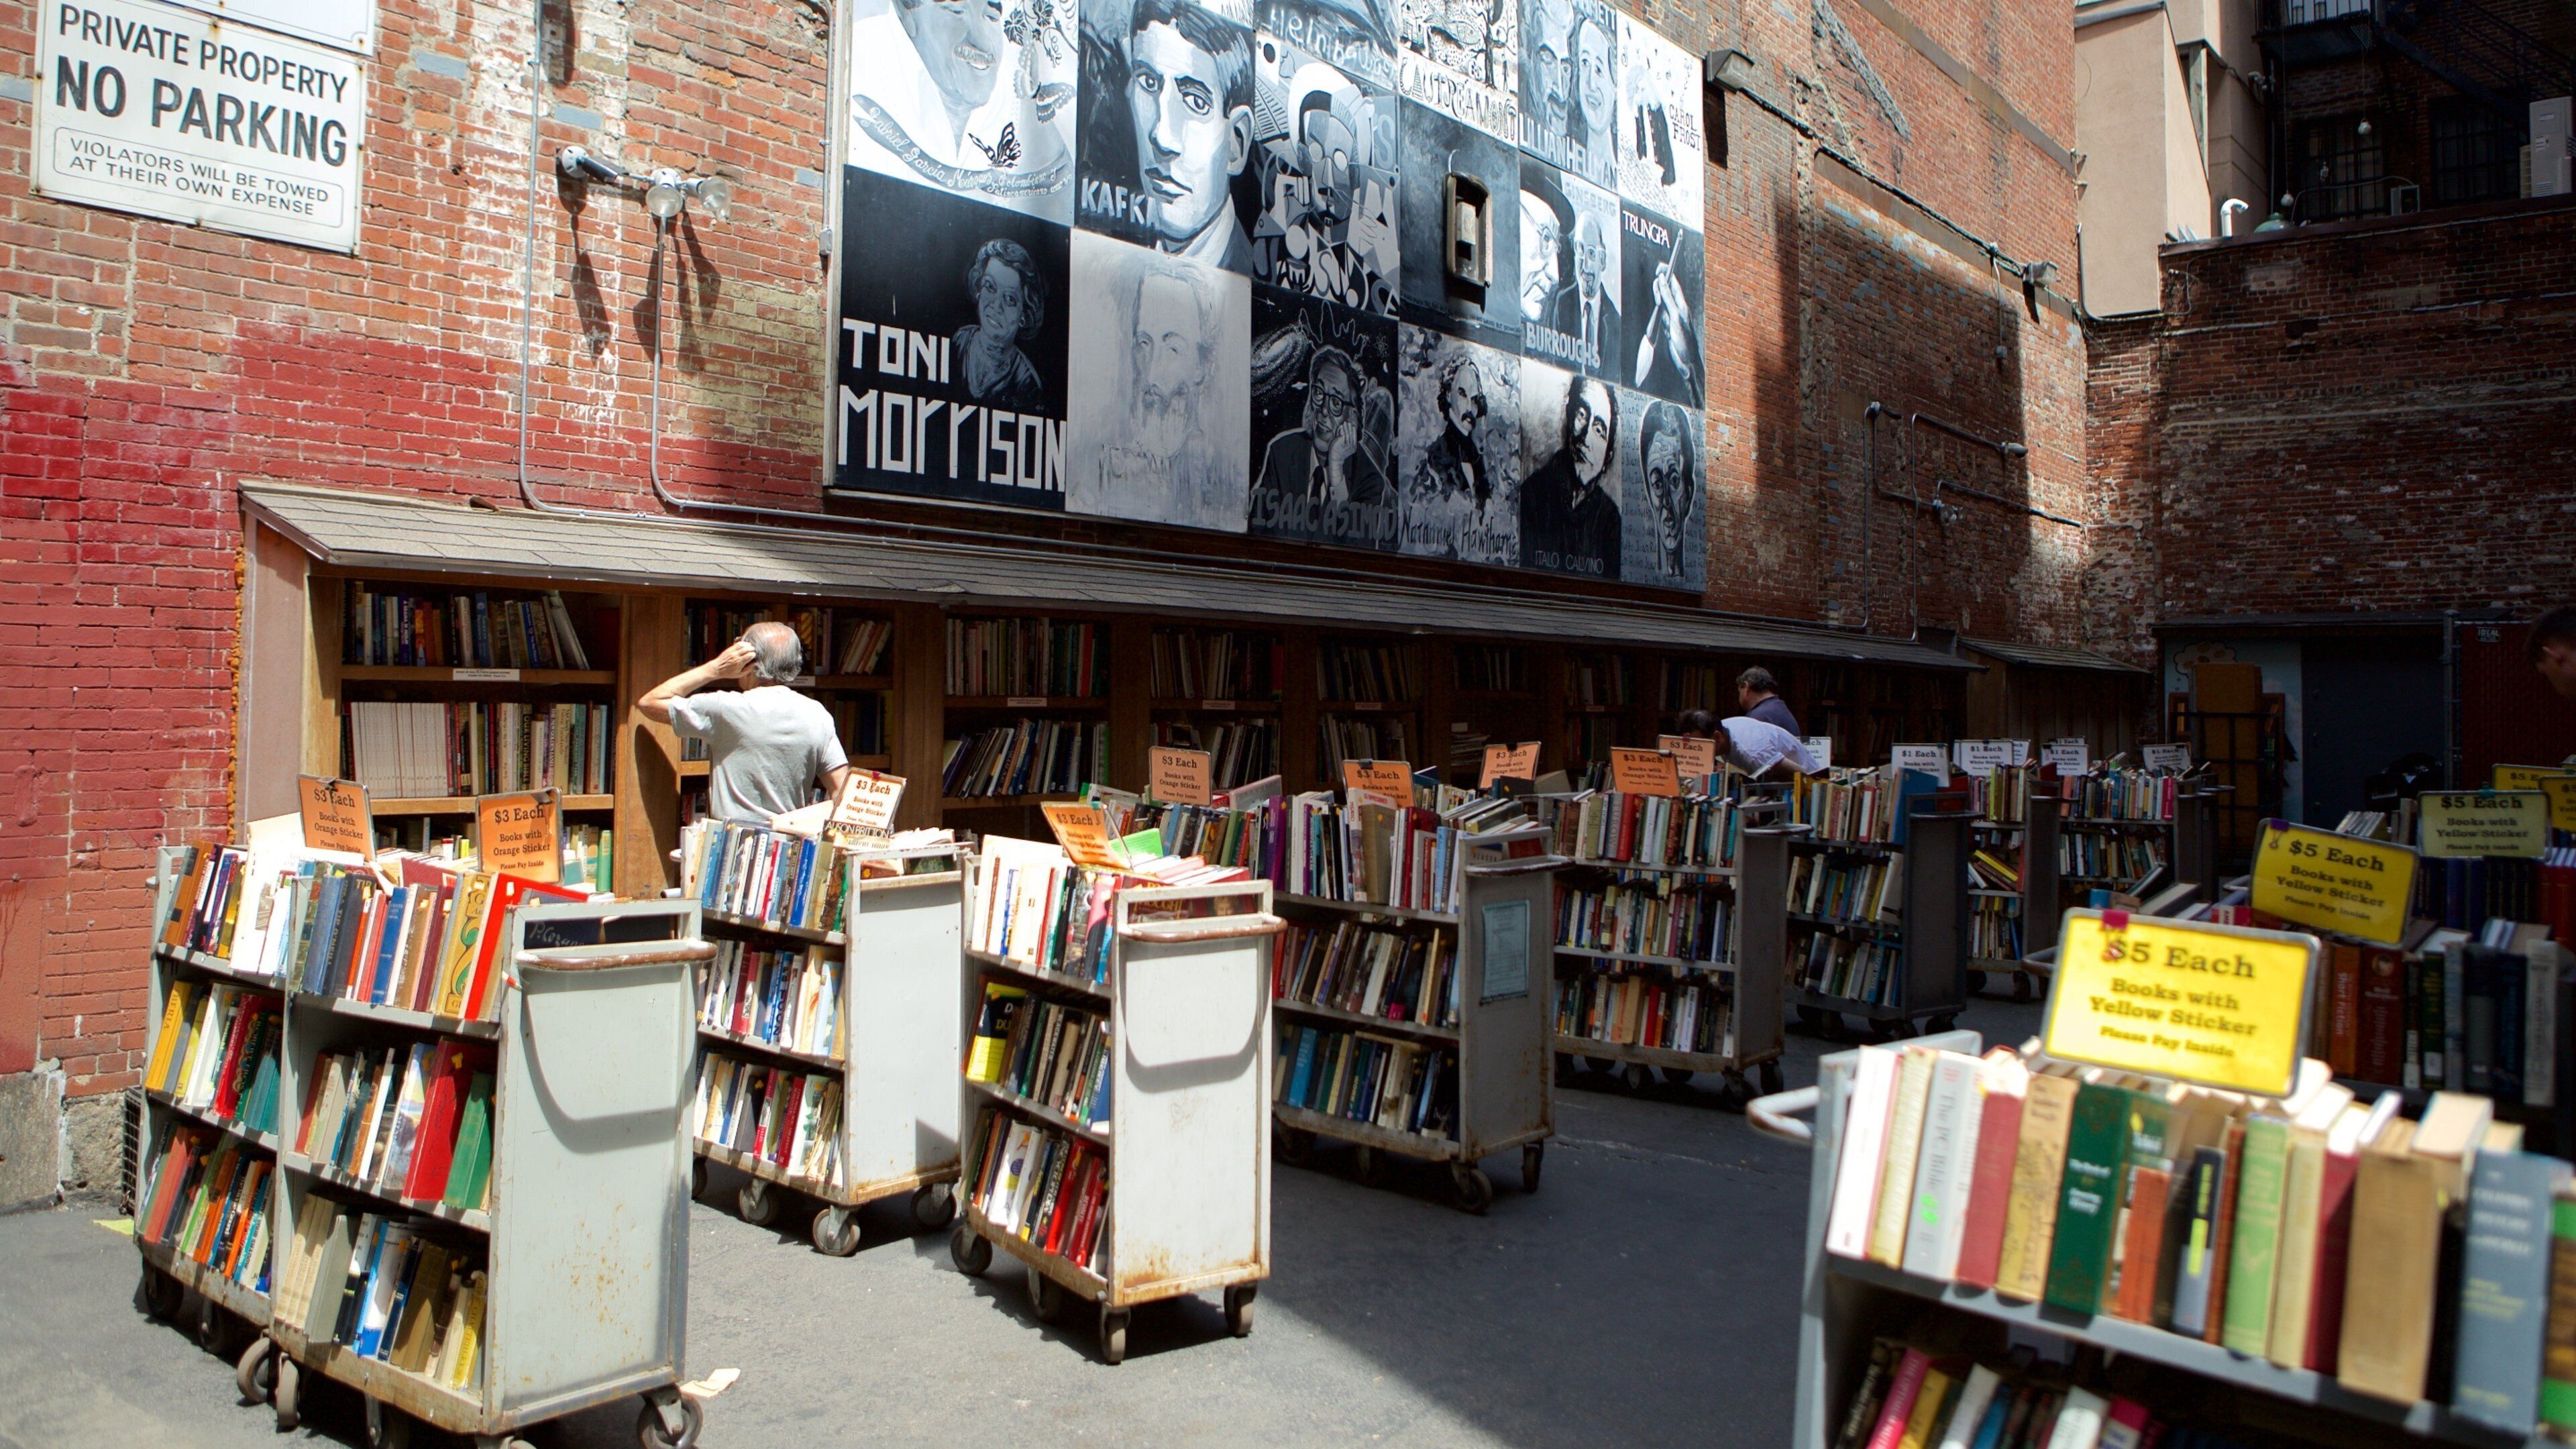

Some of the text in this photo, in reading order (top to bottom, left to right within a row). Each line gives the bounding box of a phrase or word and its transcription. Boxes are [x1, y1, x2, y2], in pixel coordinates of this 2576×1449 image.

[60, 3, 349, 103] PRIVATE PROPERTY
[56, 55, 347, 167] NO PARKING
[1668, 104, 1698, 132] CAROL
[859, 106, 911, 152] Gabriel
[1671, 122, 1701, 151] FROST
[1519, 112, 1566, 167] LILLIAN
[1565, 136, 1617, 189] HELLMAN
[70, 138, 329, 203] VIOLATORS WILL BE TOWED
[70, 156, 315, 215] AT THEIR OWN EXPENSE
[1564, 181, 1617, 216] GINSBERG
[1623, 210, 1670, 249] TRUNGPA
[843, 317, 950, 384] TONI
[1525, 322, 1601, 369] BURROUGHS
[1252, 487, 1320, 532] ISAAC
[1535, 550, 1604, 574] ITALO CALVINO
[523, 715, 531, 783] OUR LIVING BIBLE
[1496, 750, 1527, 759] $3 Each
[1623, 753, 1664, 764] $3 Each
[1670, 741, 1703, 752] $3 Each
[1901, 750, 1936, 758] $1 Each
[1162, 755, 1197, 768] $3 Each
[1159, 779, 1201, 790] Orange Sticker
[1164, 771, 1181, 780] Books
[1356, 769, 1401, 780] $3 Each
[2510, 772, 2526, 781] $5
[313, 788, 355, 808] $3 Each
[856, 780, 891, 794] $3 Each
[494, 803, 545, 824] $3 Each
[846, 803, 886, 817] Orange Sticker
[853, 796, 883, 808] Books with
[2440, 795, 2524, 810] $5 Each
[319, 812, 356, 826] Books with
[1056, 812, 1093, 826] $3 Each
[2447, 818, 2518, 826] Books with
[314, 822, 364, 841] Orange Sticker
[500, 829, 543, 843] Books with
[2436, 829, 2528, 838] Yellow Sticker
[319, 839, 336, 849] Please
[337, 843, 345, 851] Pay
[493, 842, 551, 857] Orange Sticker
[2288, 839, 2385, 872] $5 Each
[500, 862, 516, 870] Please
[517, 862, 527, 870] Pay
[2290, 865, 2373, 892] Books with
[2277, 876, 2385, 908] Yellow Sticker
[335, 907, 345, 926] TIP
[2284, 894, 2371, 921] Please Pay Inside
[325, 926, 341, 966] O'NEILL
[2108, 940, 2255, 979] $5 Each
[2110, 978, 2240, 1012] Books with
[2334, 971, 2348, 1036] Short Fiction
[2090, 996, 2257, 1037] Yellow Sticker
[1048, 1012, 1063, 1061] BLACKWATER
[2100, 1026, 2236, 1058] Please Pay Inside
[252, 1218, 262, 1238] YOUR
[244, 1238, 256, 1269] SHADOW
